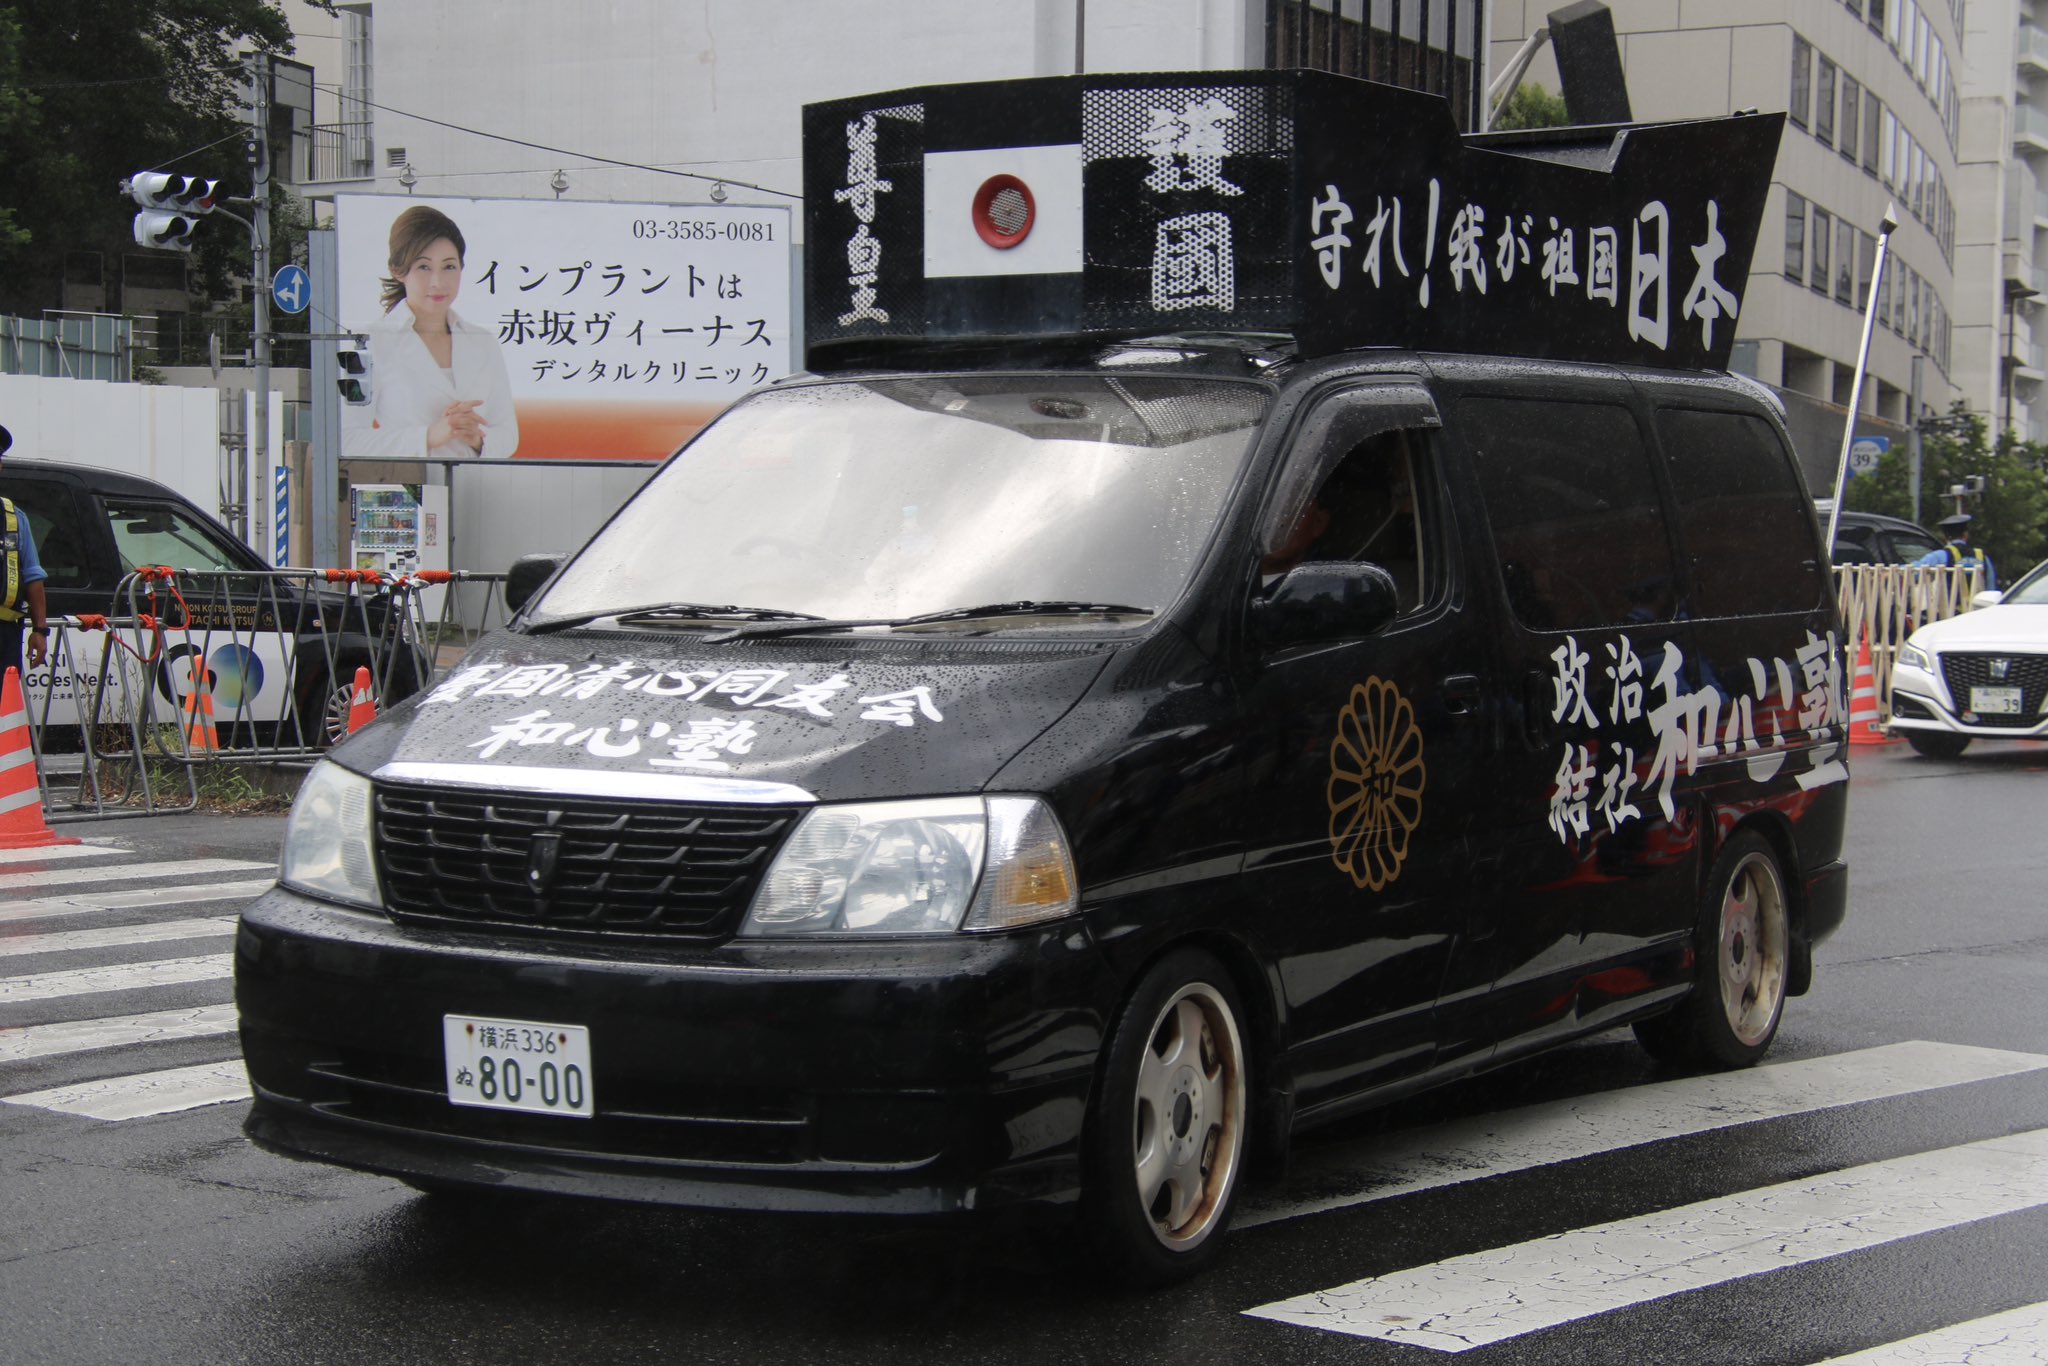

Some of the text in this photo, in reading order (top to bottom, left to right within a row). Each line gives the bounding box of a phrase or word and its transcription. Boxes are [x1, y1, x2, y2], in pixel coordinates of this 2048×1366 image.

[632, 218, 776, 242] 03-3585-0081
[475, 259, 744, 300] インプラントは
[497, 308, 773, 347] 赤坂ヴィーナス
[531, 358, 770, 386] デンタルクリニック
[75, 672, 118, 687] Net.
[1550, 633, 1644, 729] 政治
[467, 708, 756, 772] 和心塾
[1641, 629, 1850, 824] 和心塾
[1361, 751, 1397, 823] 和
[1547, 741, 1642, 846] 結社
[479, 1055, 584, 1110] 80-00
